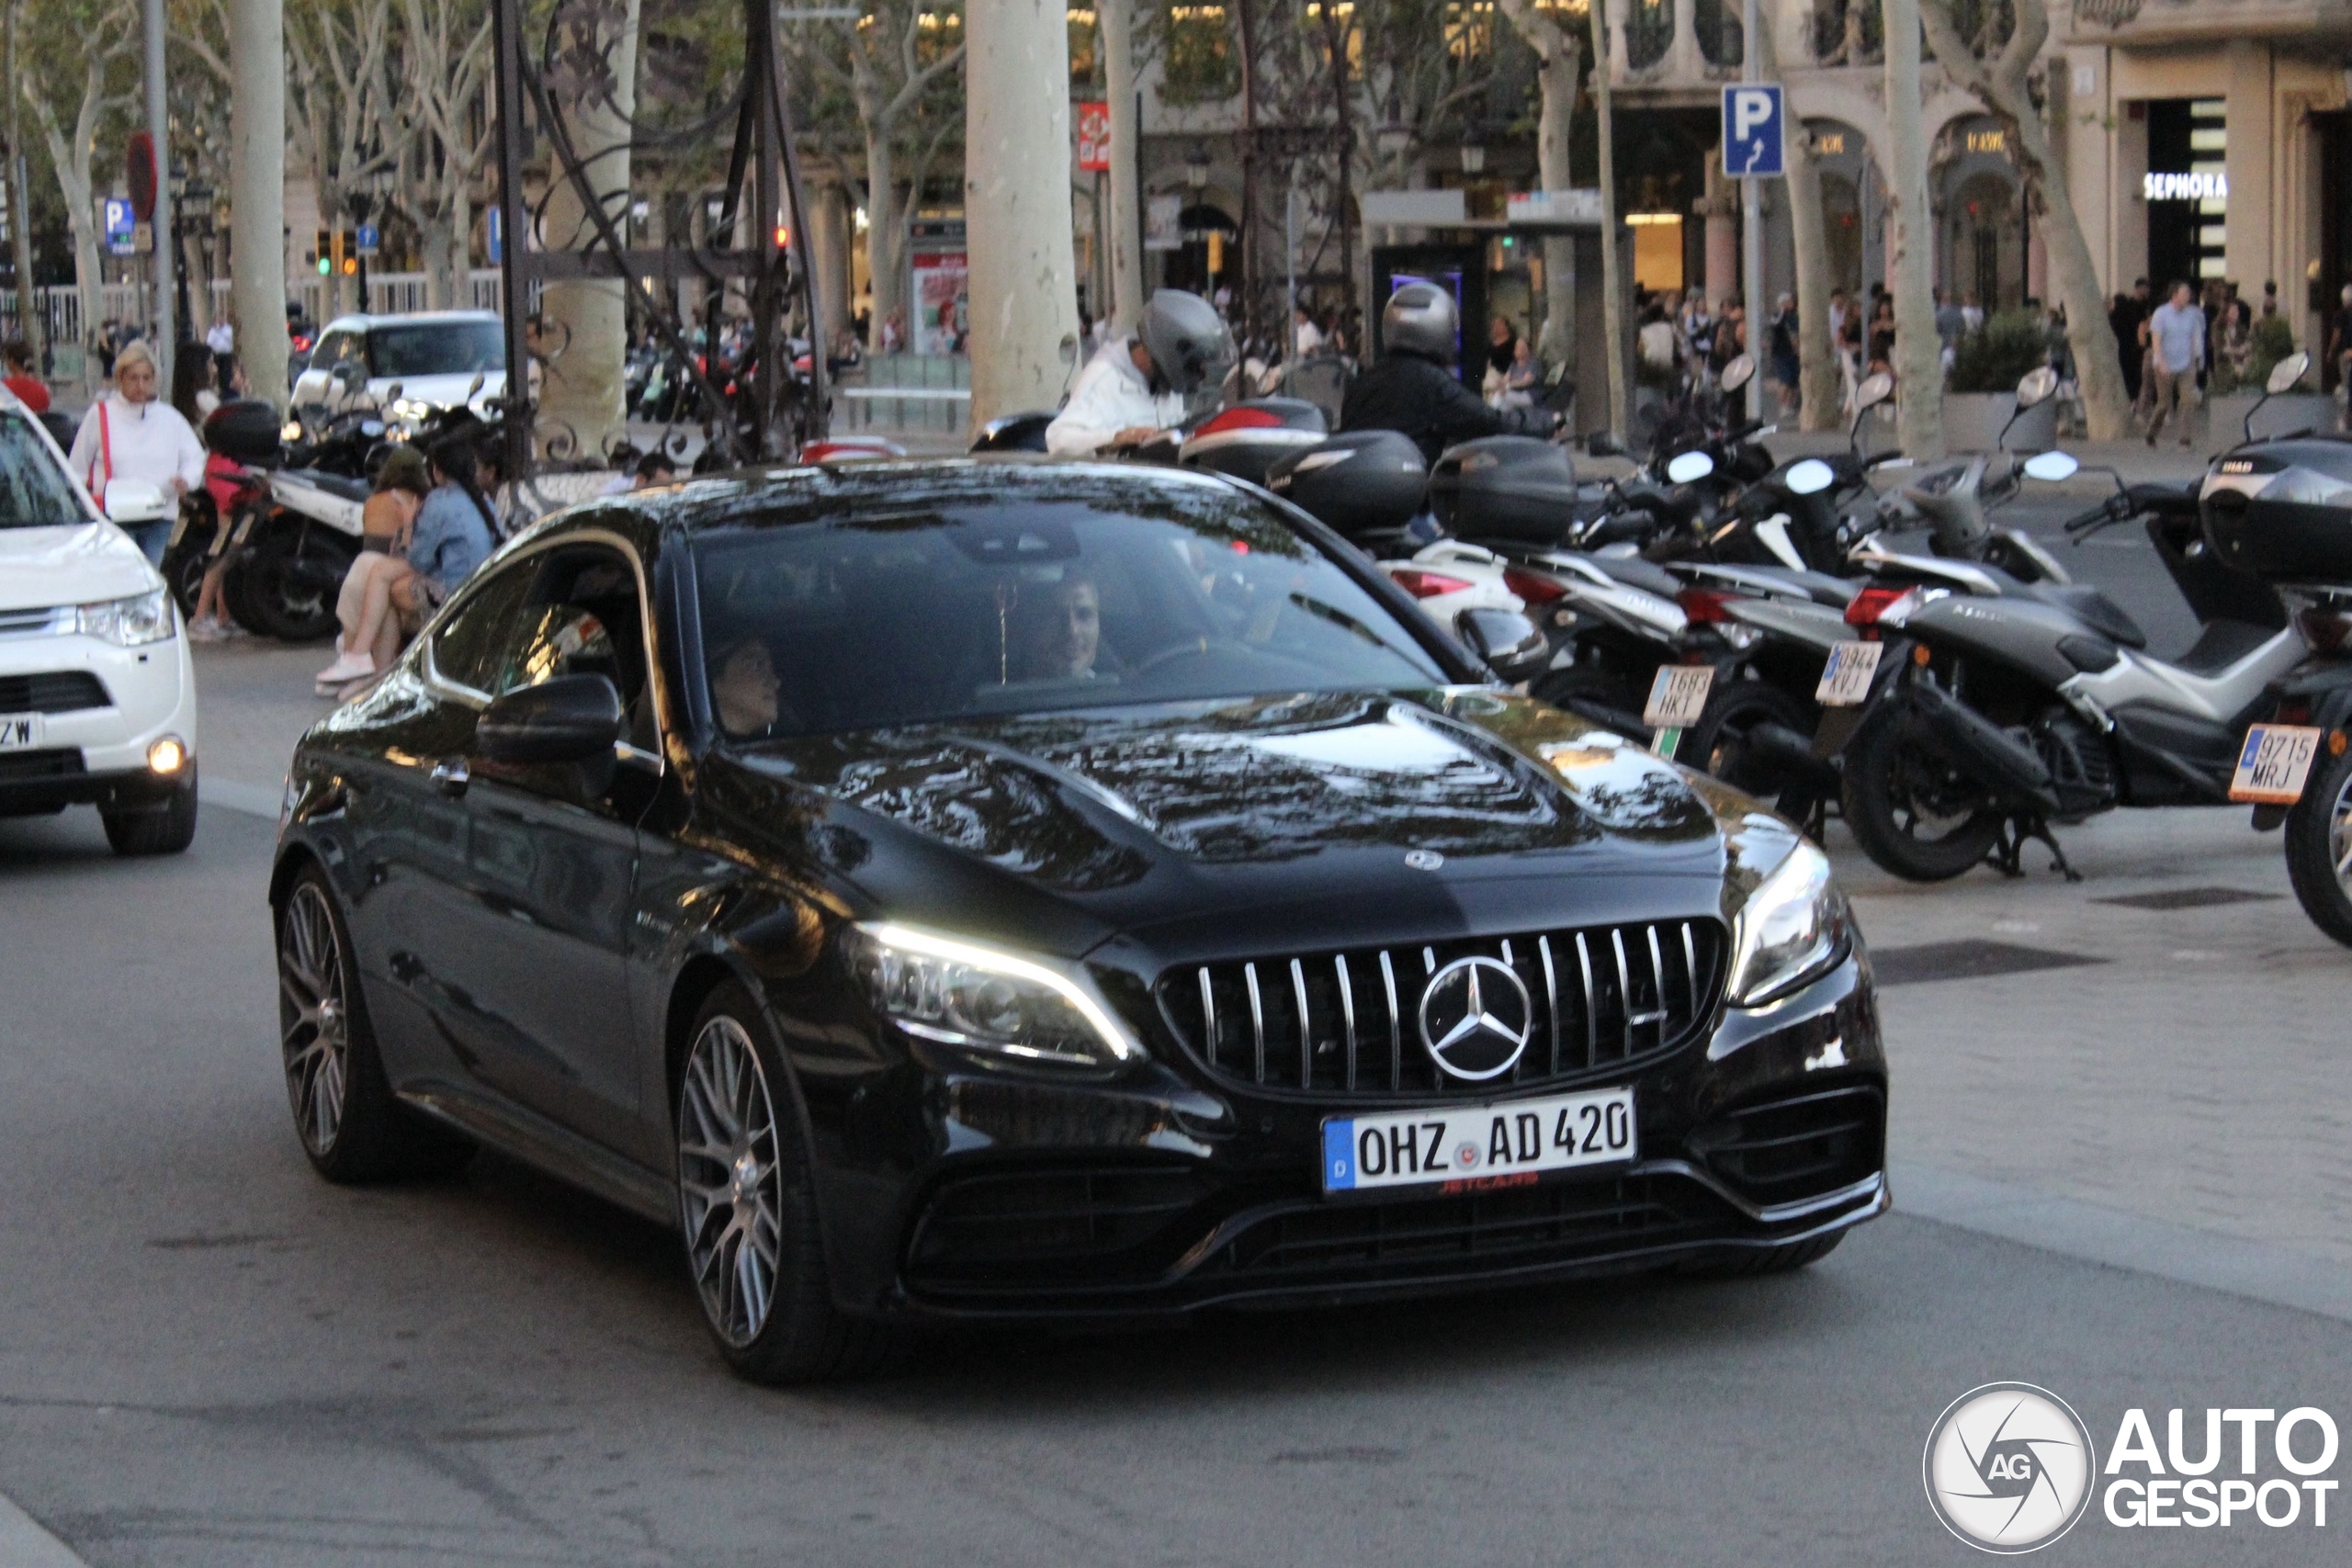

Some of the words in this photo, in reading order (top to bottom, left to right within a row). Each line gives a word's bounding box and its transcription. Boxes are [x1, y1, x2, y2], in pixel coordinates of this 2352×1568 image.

[1735, 90, 1773, 141] P
[2143, 172, 2229, 199] SEPHORA
[107, 200, 123, 233] P
[1838, 647, 1875, 671] 0944
[1668, 671, 1709, 694] 1683
[1828, 671, 1860, 694] KVJ
[2260, 735, 2312, 763] 9715
[2250, 763, 2291, 789] MRJ
[1359, 1122, 1449, 1176] OHZ
[1487, 1113, 1541, 1166] AD
[1554, 1101, 1629, 1156] 420
